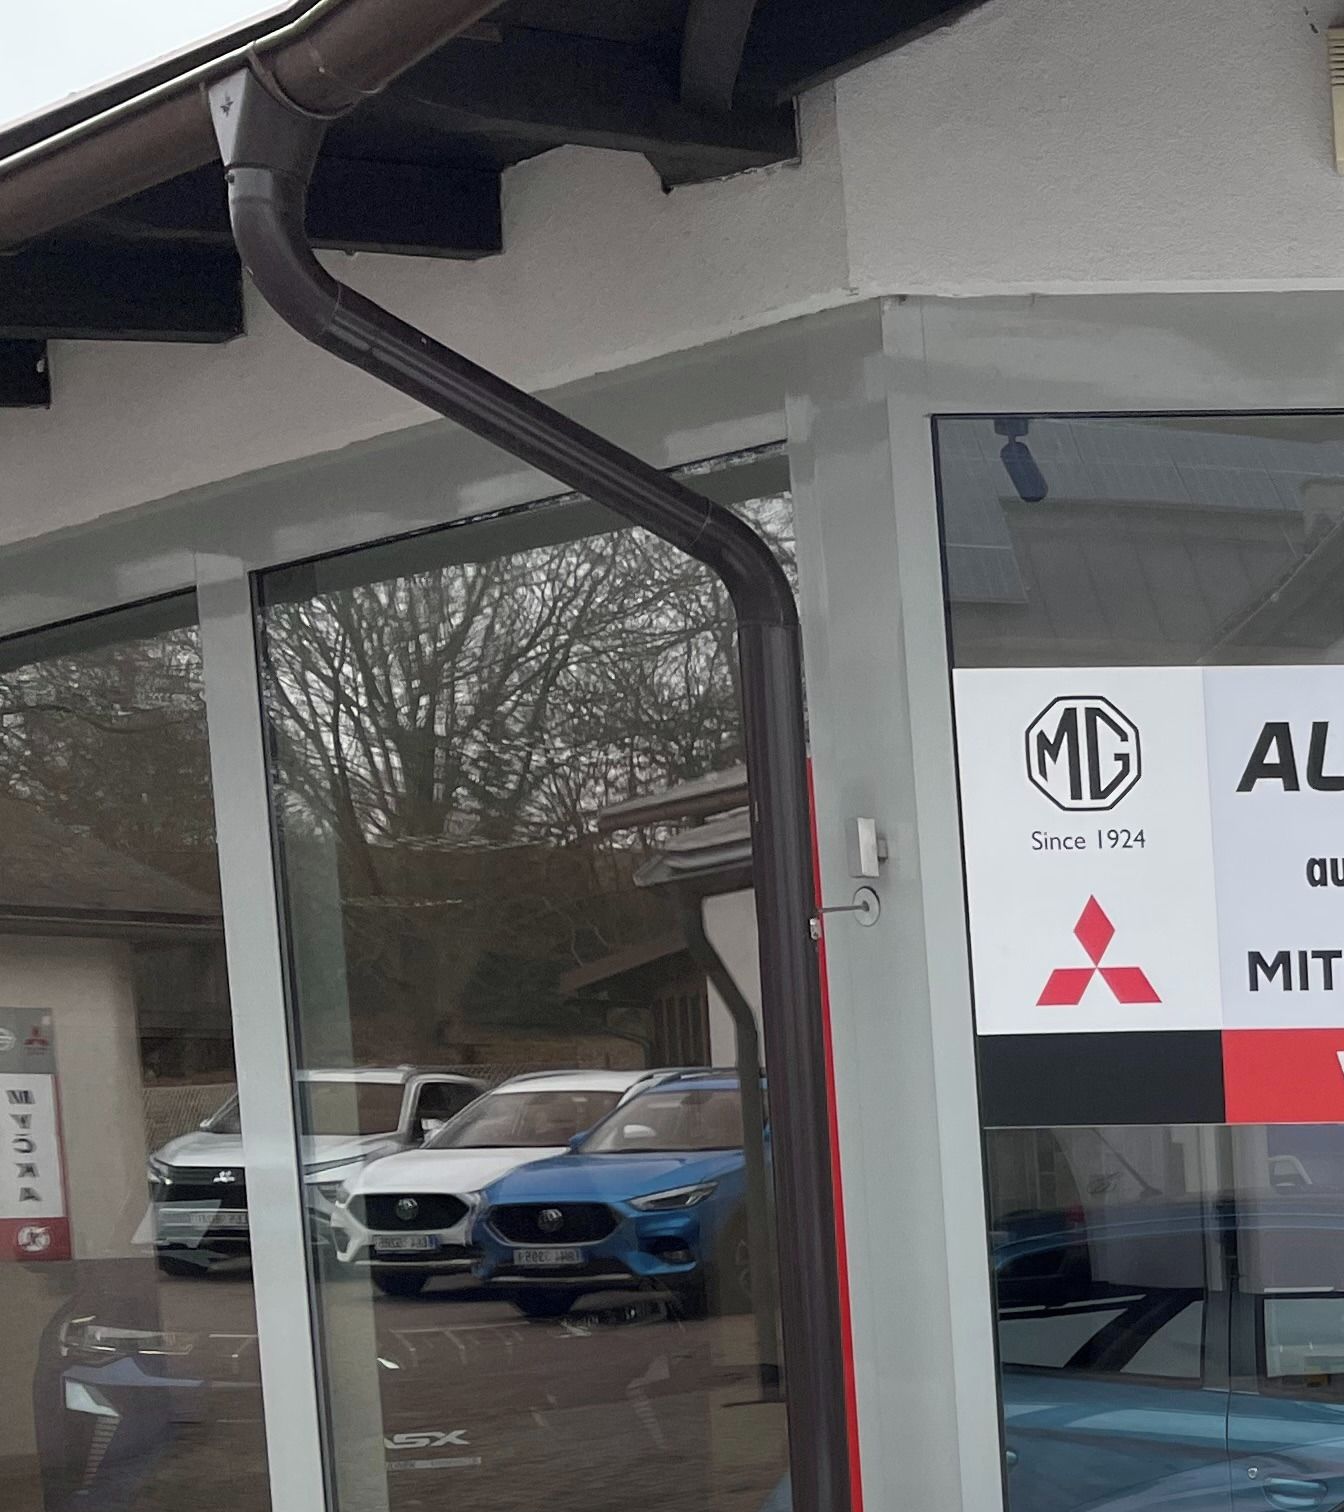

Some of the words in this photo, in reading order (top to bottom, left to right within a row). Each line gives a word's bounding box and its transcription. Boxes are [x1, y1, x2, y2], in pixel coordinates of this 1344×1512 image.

[1037, 707, 1130, 800] MG
[1031, 831, 1087, 851] Since
[1098, 829, 1146, 849] 1924
